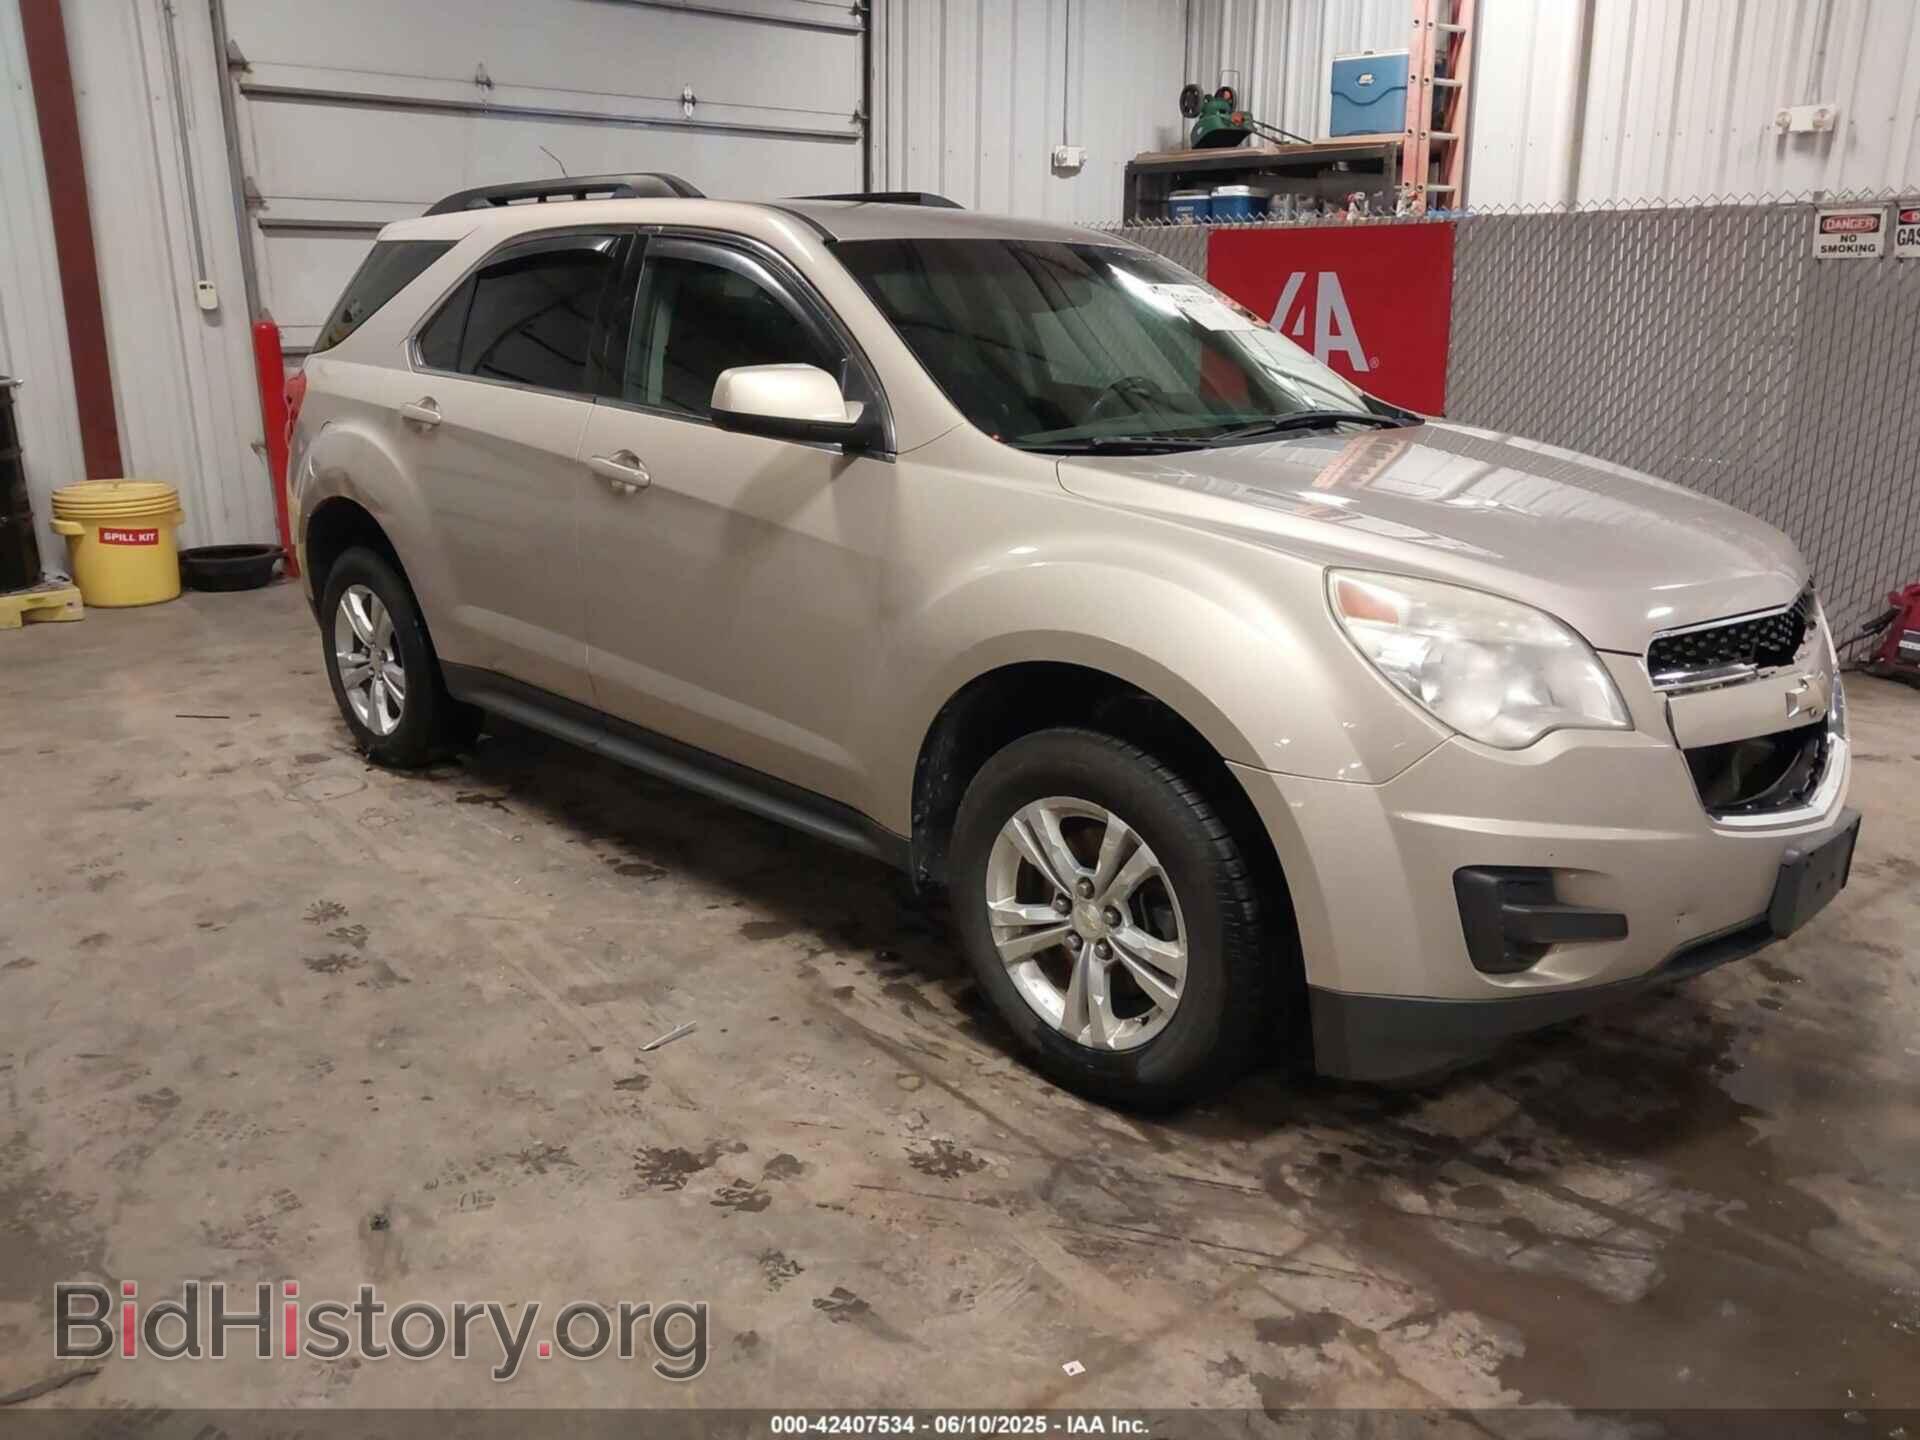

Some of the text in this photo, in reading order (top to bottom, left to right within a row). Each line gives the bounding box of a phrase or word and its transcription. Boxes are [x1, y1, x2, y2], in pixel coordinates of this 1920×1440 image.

[1826, 217, 1874, 231] DANGER
[1840, 234, 1857, 243] NO
[1820, 244, 1876, 254] SMOKING
[103, 532, 155, 542] SPILL KIT
